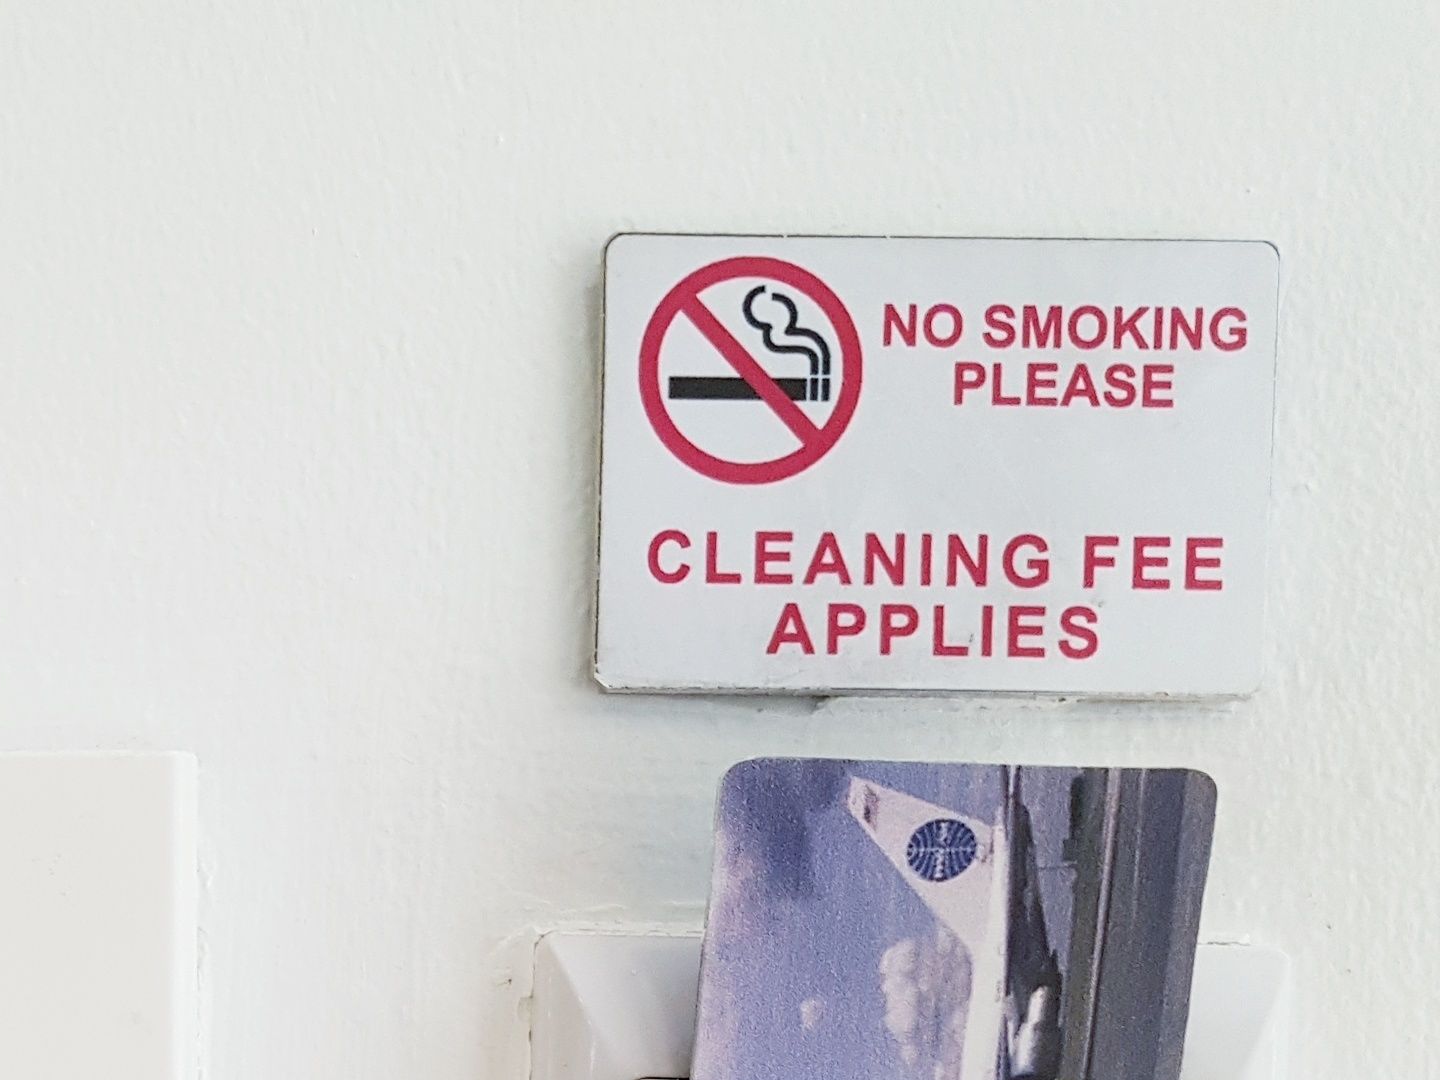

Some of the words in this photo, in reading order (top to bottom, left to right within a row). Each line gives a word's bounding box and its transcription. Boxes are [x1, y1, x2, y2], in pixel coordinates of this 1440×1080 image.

[883, 303, 965, 349] NO
[983, 303, 1249, 353] SMOKING
[954, 361, 1175, 409] PLEASE
[647, 528, 1051, 590] CLEANING
[1083, 535, 1224, 592] FEE
[767, 602, 1100, 661] APPLIES
